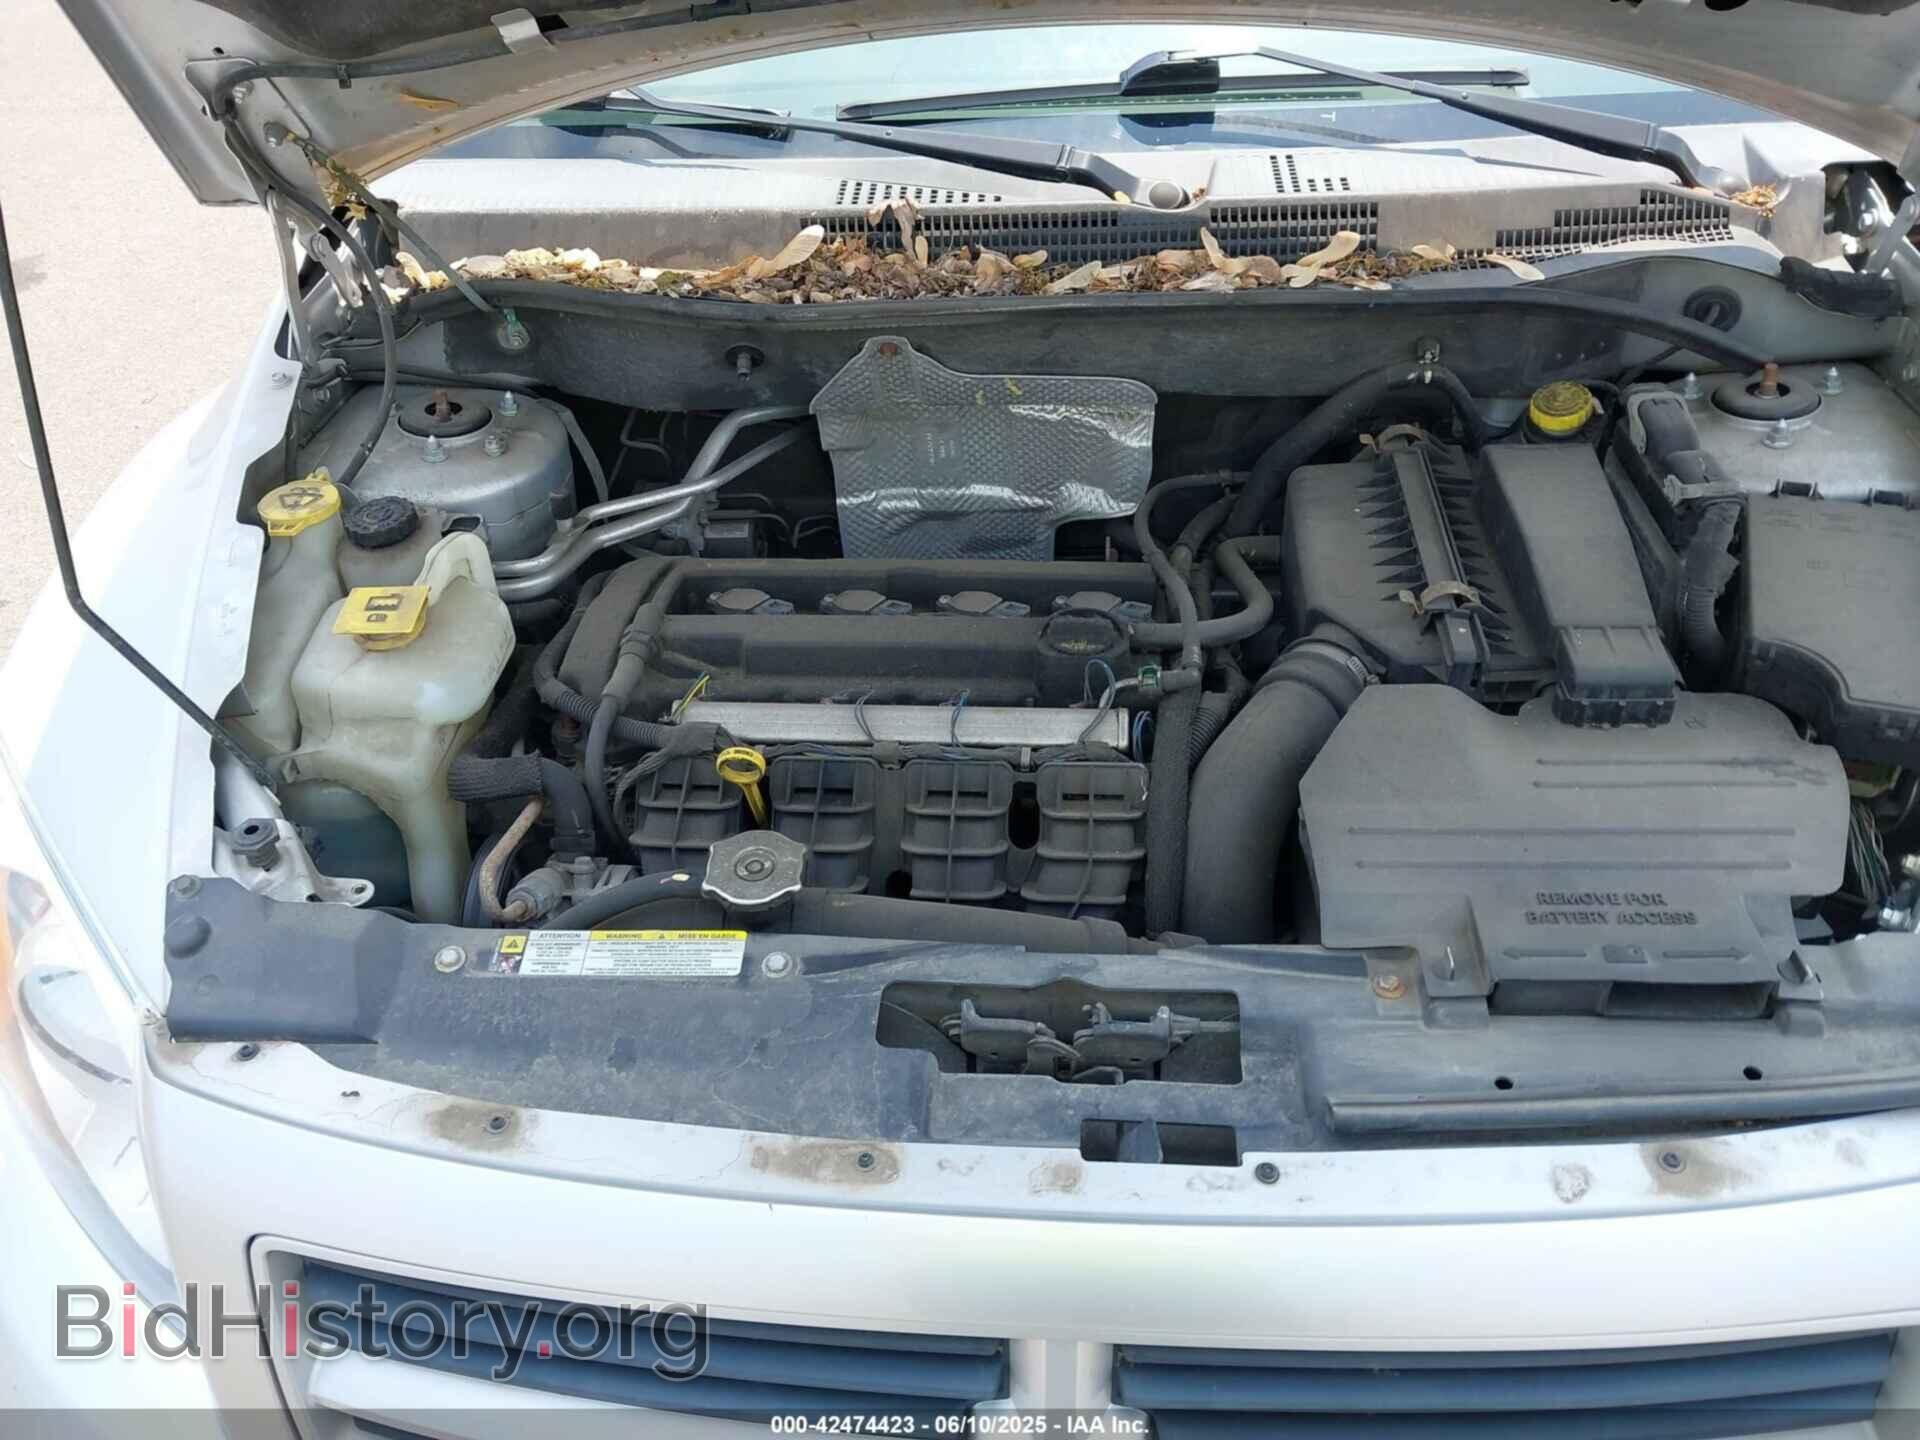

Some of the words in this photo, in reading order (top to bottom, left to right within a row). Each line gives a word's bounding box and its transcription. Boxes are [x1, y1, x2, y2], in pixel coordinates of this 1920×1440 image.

[1536, 892, 1621, 906] REMOVE
[1622, 893, 1668, 906] FOR
[1525, 911, 1609, 925] BATTERY
[1616, 911, 1698, 925] ACCESS
